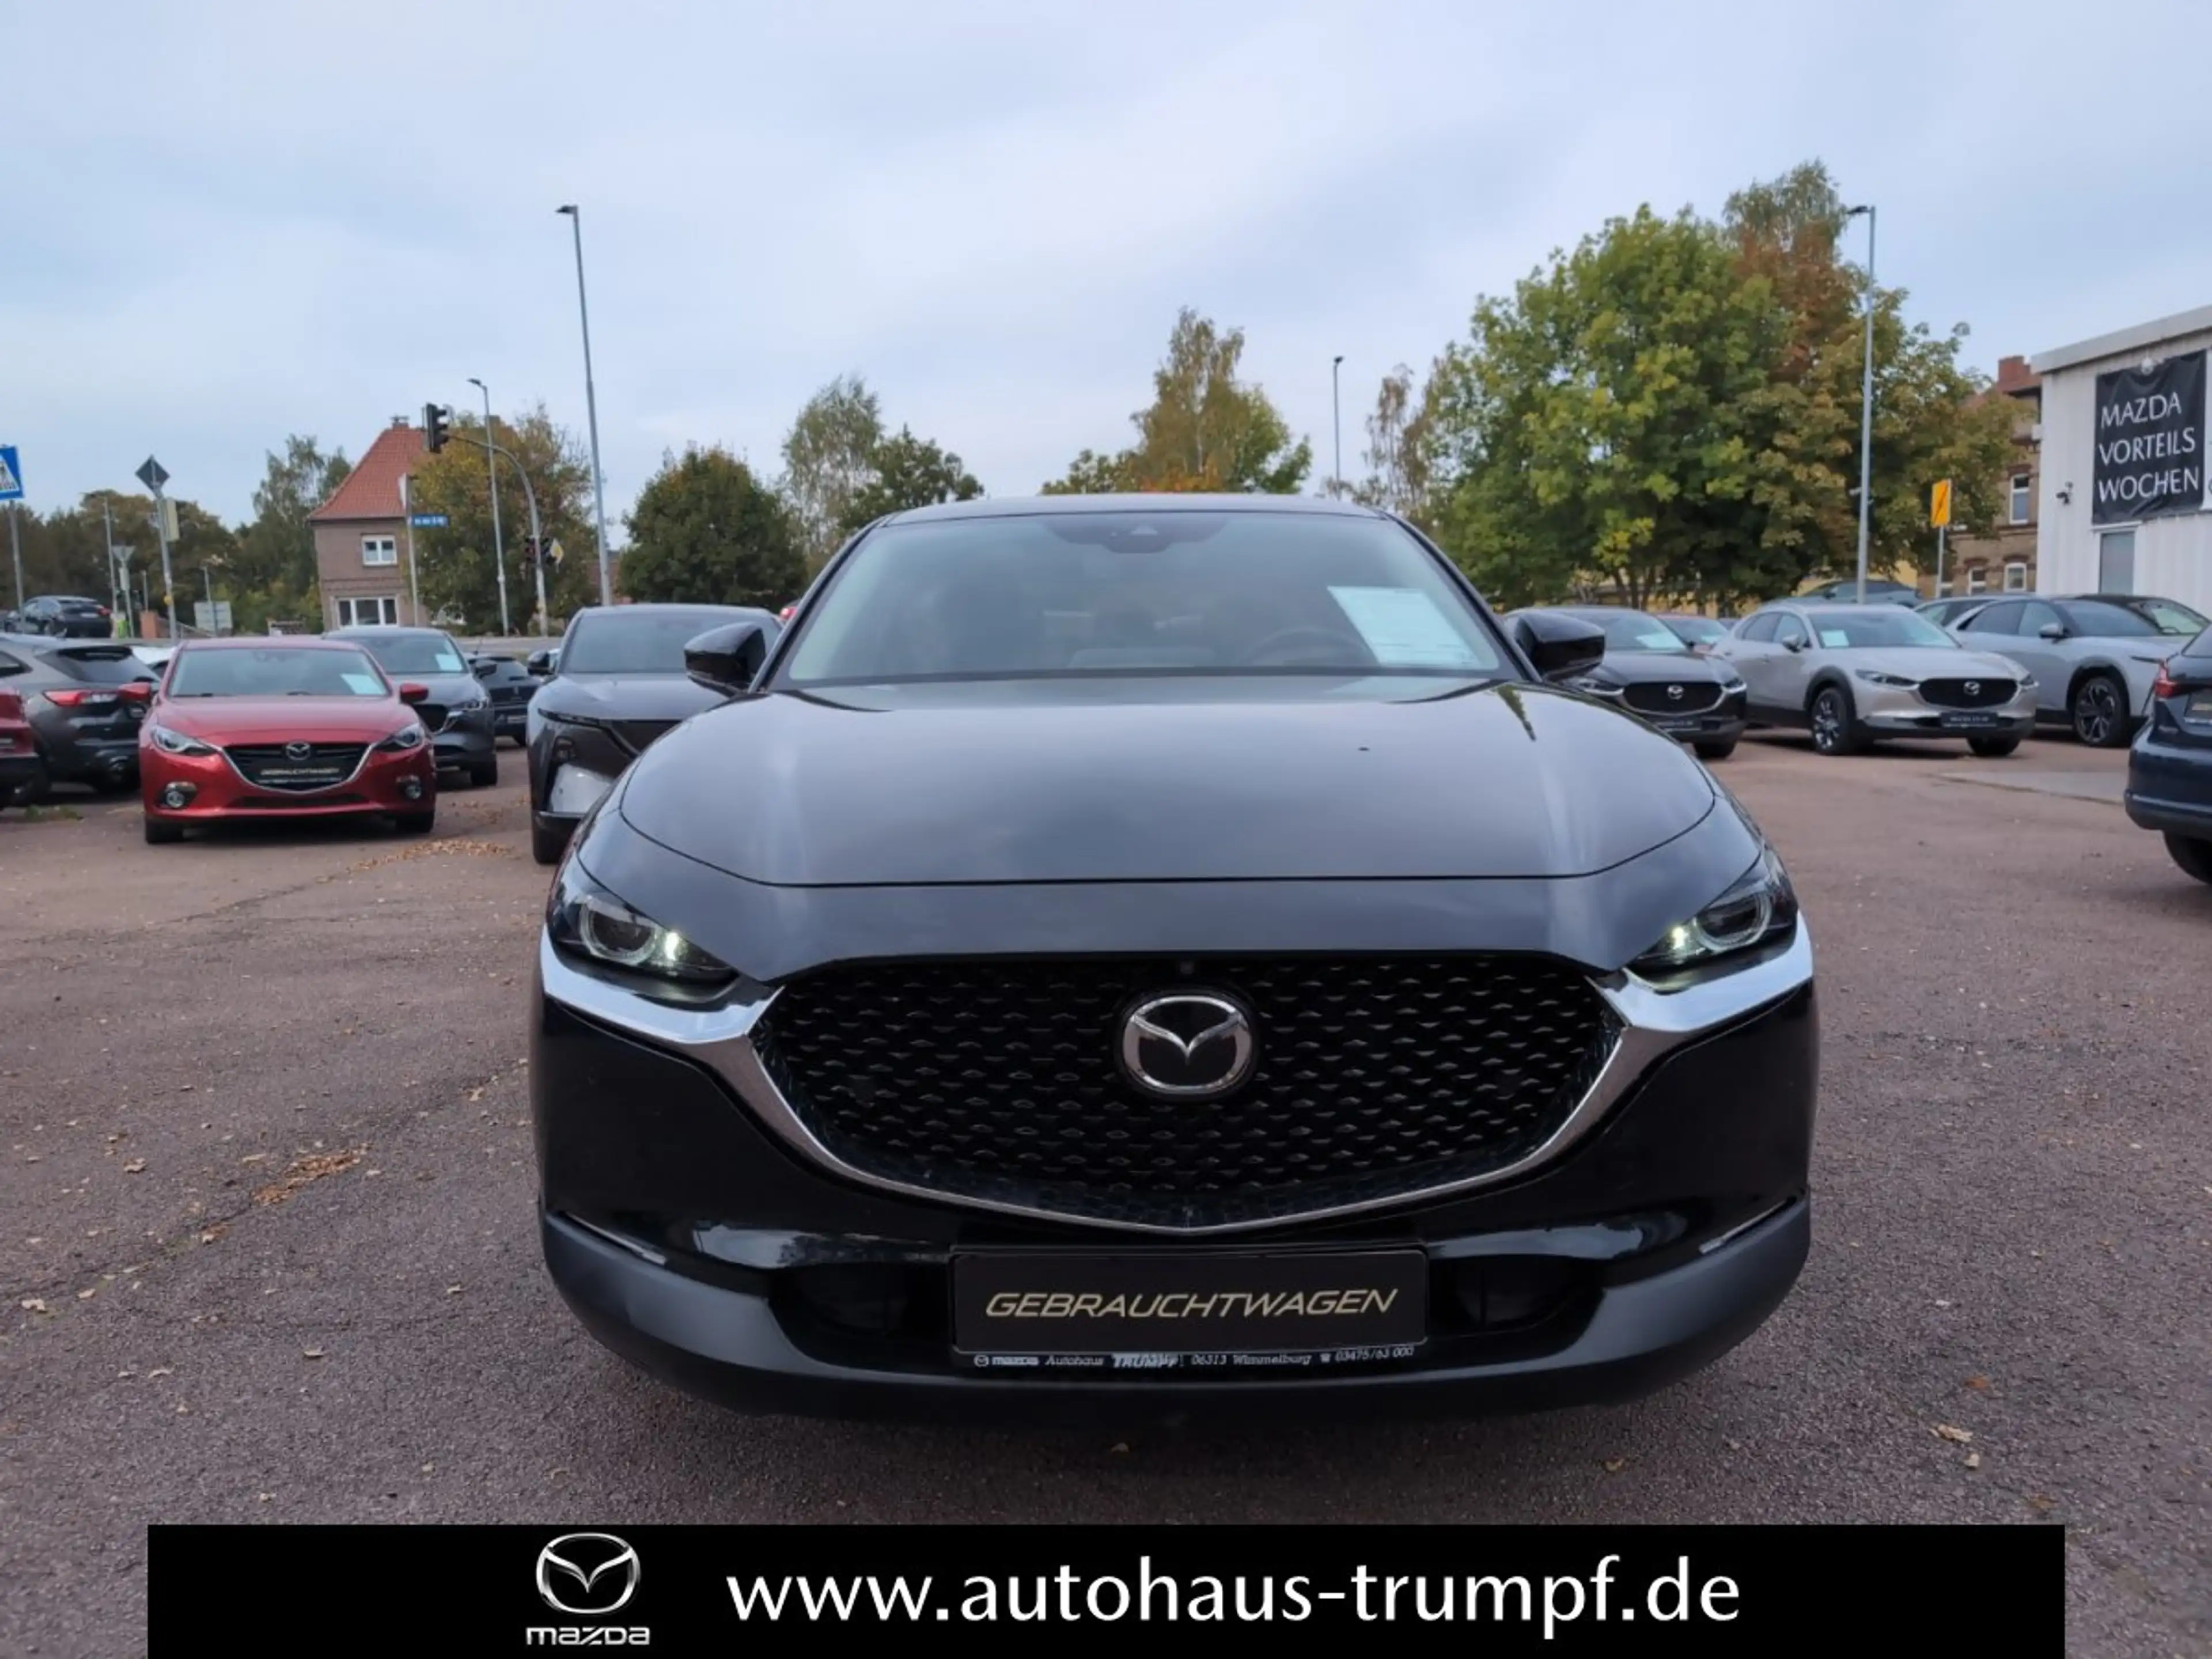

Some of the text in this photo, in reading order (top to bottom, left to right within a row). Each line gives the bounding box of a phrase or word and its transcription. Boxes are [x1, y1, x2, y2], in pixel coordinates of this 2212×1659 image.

[2101, 391, 2181, 429] MAZDA
[2099, 427, 2195, 466] VORTEILS
[2098, 465, 2199, 503] WOCHEN
[986, 1289, 1399, 1317] GEBRAUCHTWAGEN
[1044, 1355, 1104, 1366] Autohaus
